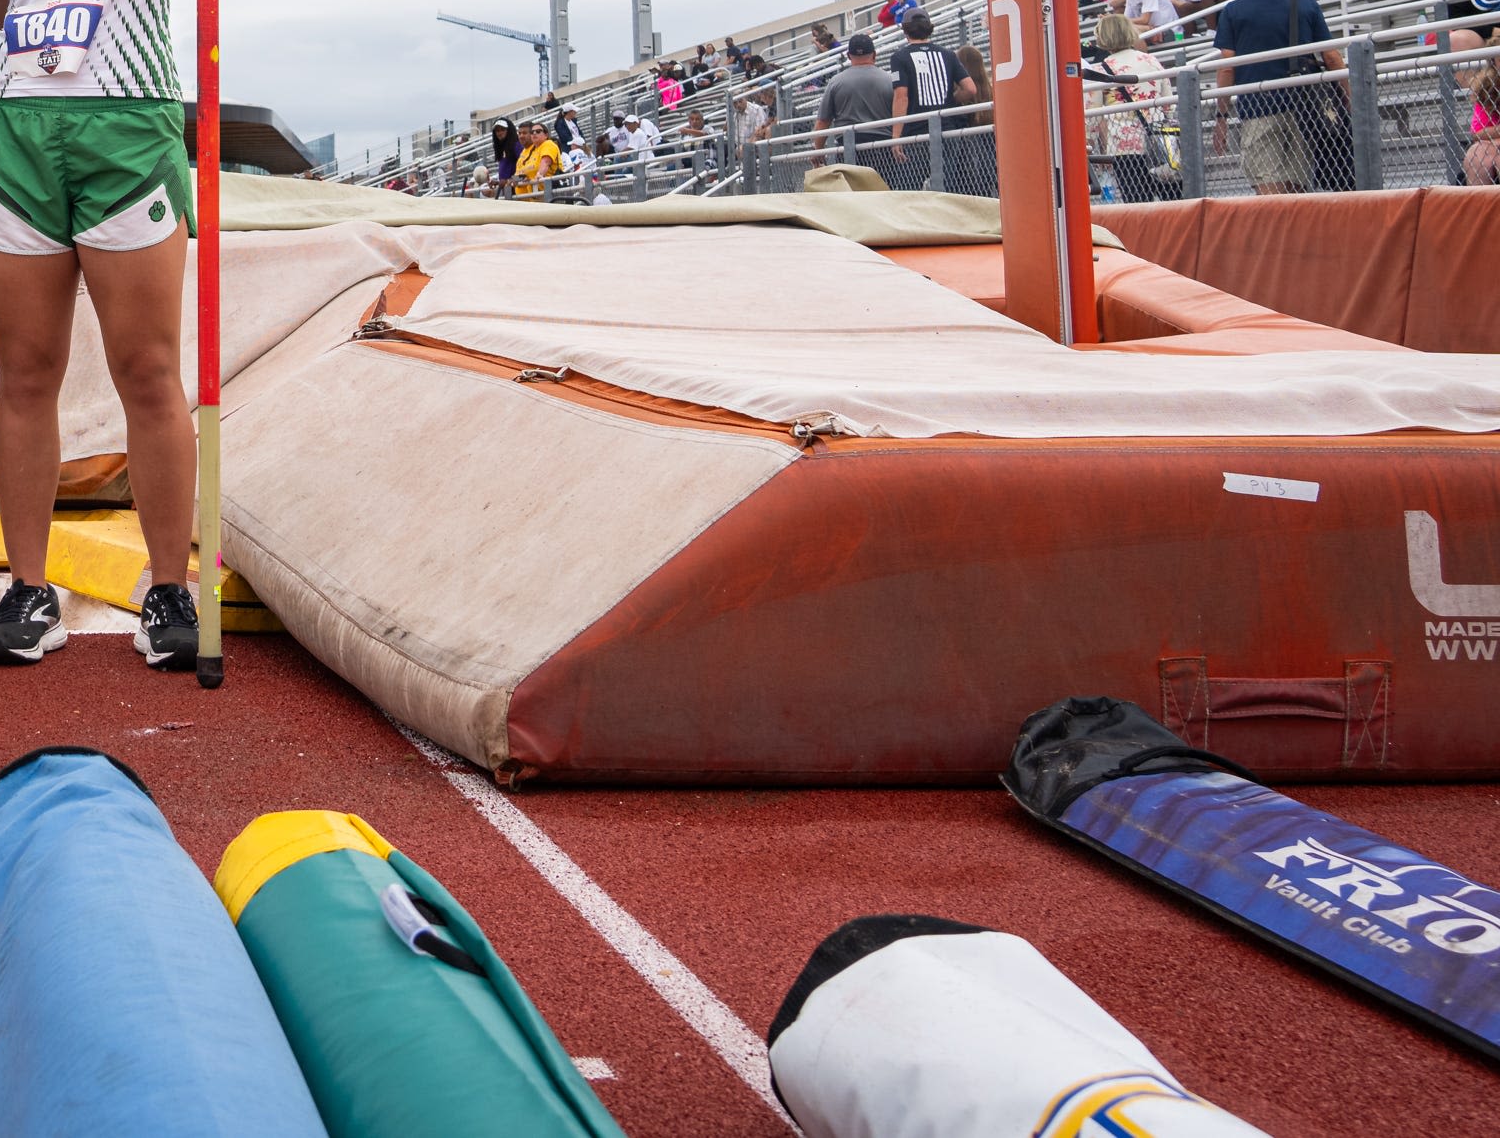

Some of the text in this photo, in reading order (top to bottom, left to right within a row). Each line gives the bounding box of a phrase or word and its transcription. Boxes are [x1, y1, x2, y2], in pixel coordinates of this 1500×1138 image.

[13, 7, 91, 48] 1840
[38, 55, 61, 66] STATE
[1425, 621, 1500, 637] MADE
[1252, 839, 1500, 955] FRIO
[1264, 874, 1413, 953] Vault Club
